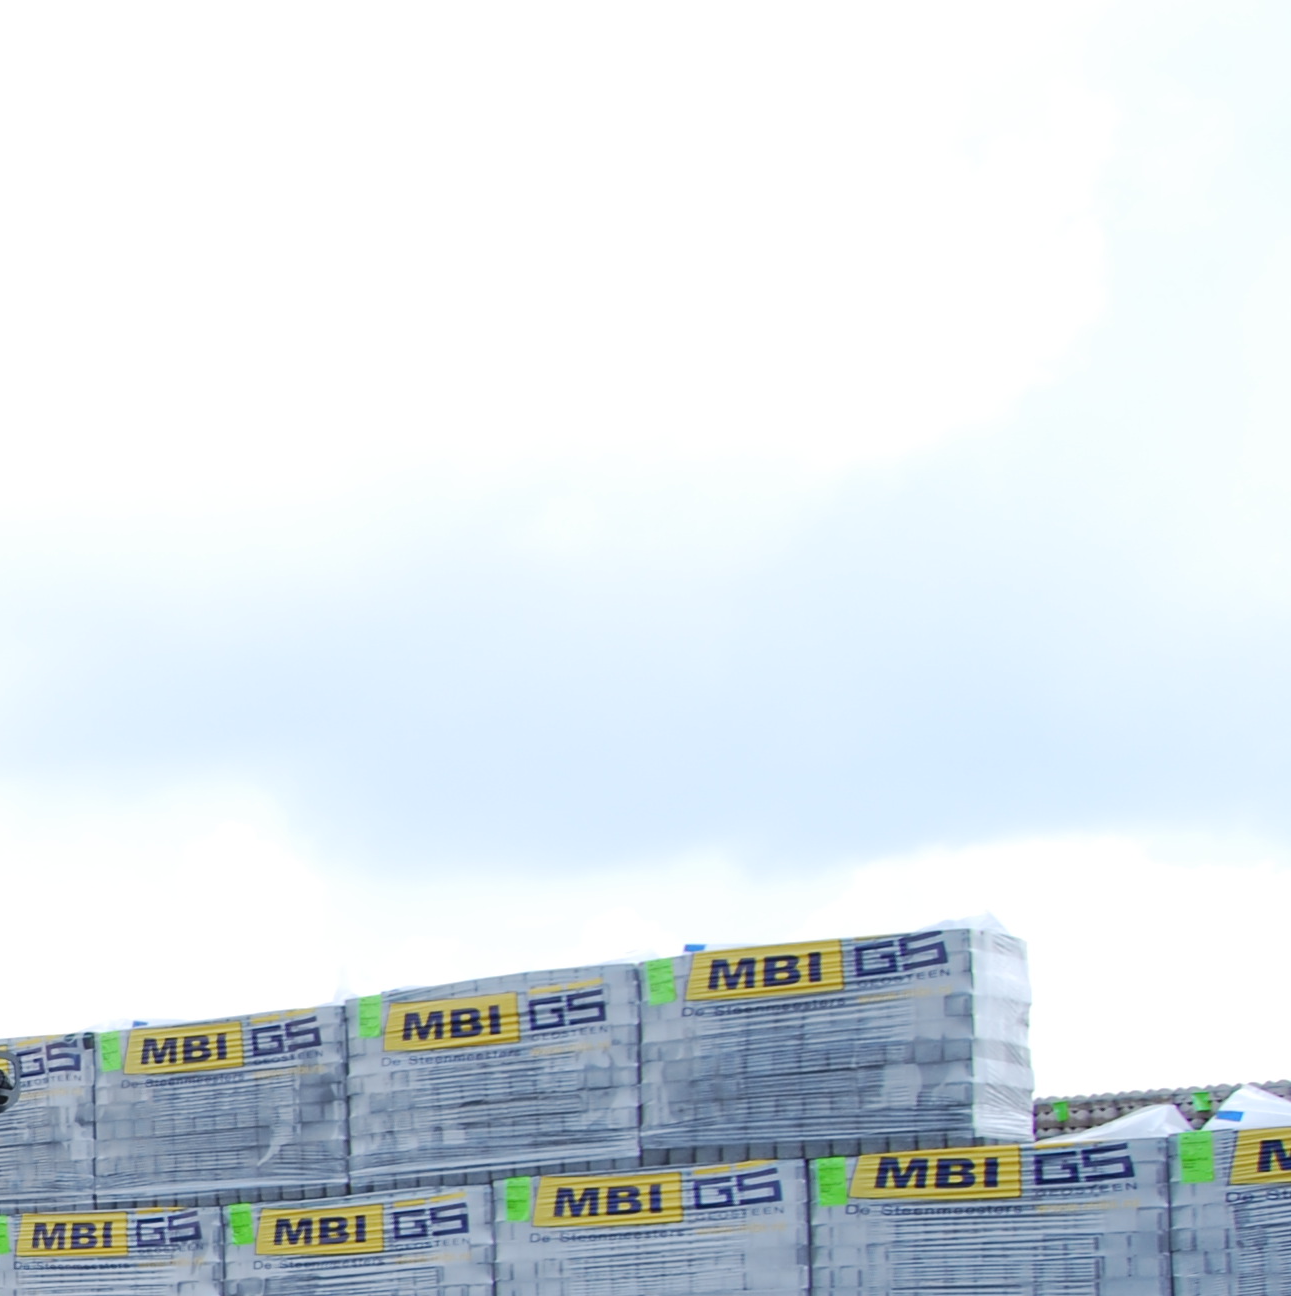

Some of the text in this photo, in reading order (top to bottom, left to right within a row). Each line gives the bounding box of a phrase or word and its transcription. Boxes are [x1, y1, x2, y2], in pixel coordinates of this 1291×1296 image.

[708, 952, 822, 991] MBI
[854, 930, 948, 977] GS
[402, 989, 606, 1041] MBI GS
[141, 1016, 322, 1064] MBI GS
[874, 1156, 999, 1189] MBI
[1034, 1142, 1135, 1186] GS
[553, 1167, 783, 1218] MBI GS
[32, 1211, 202, 1249] MBI GS
[274, 1202, 469, 1246] MBI GS
